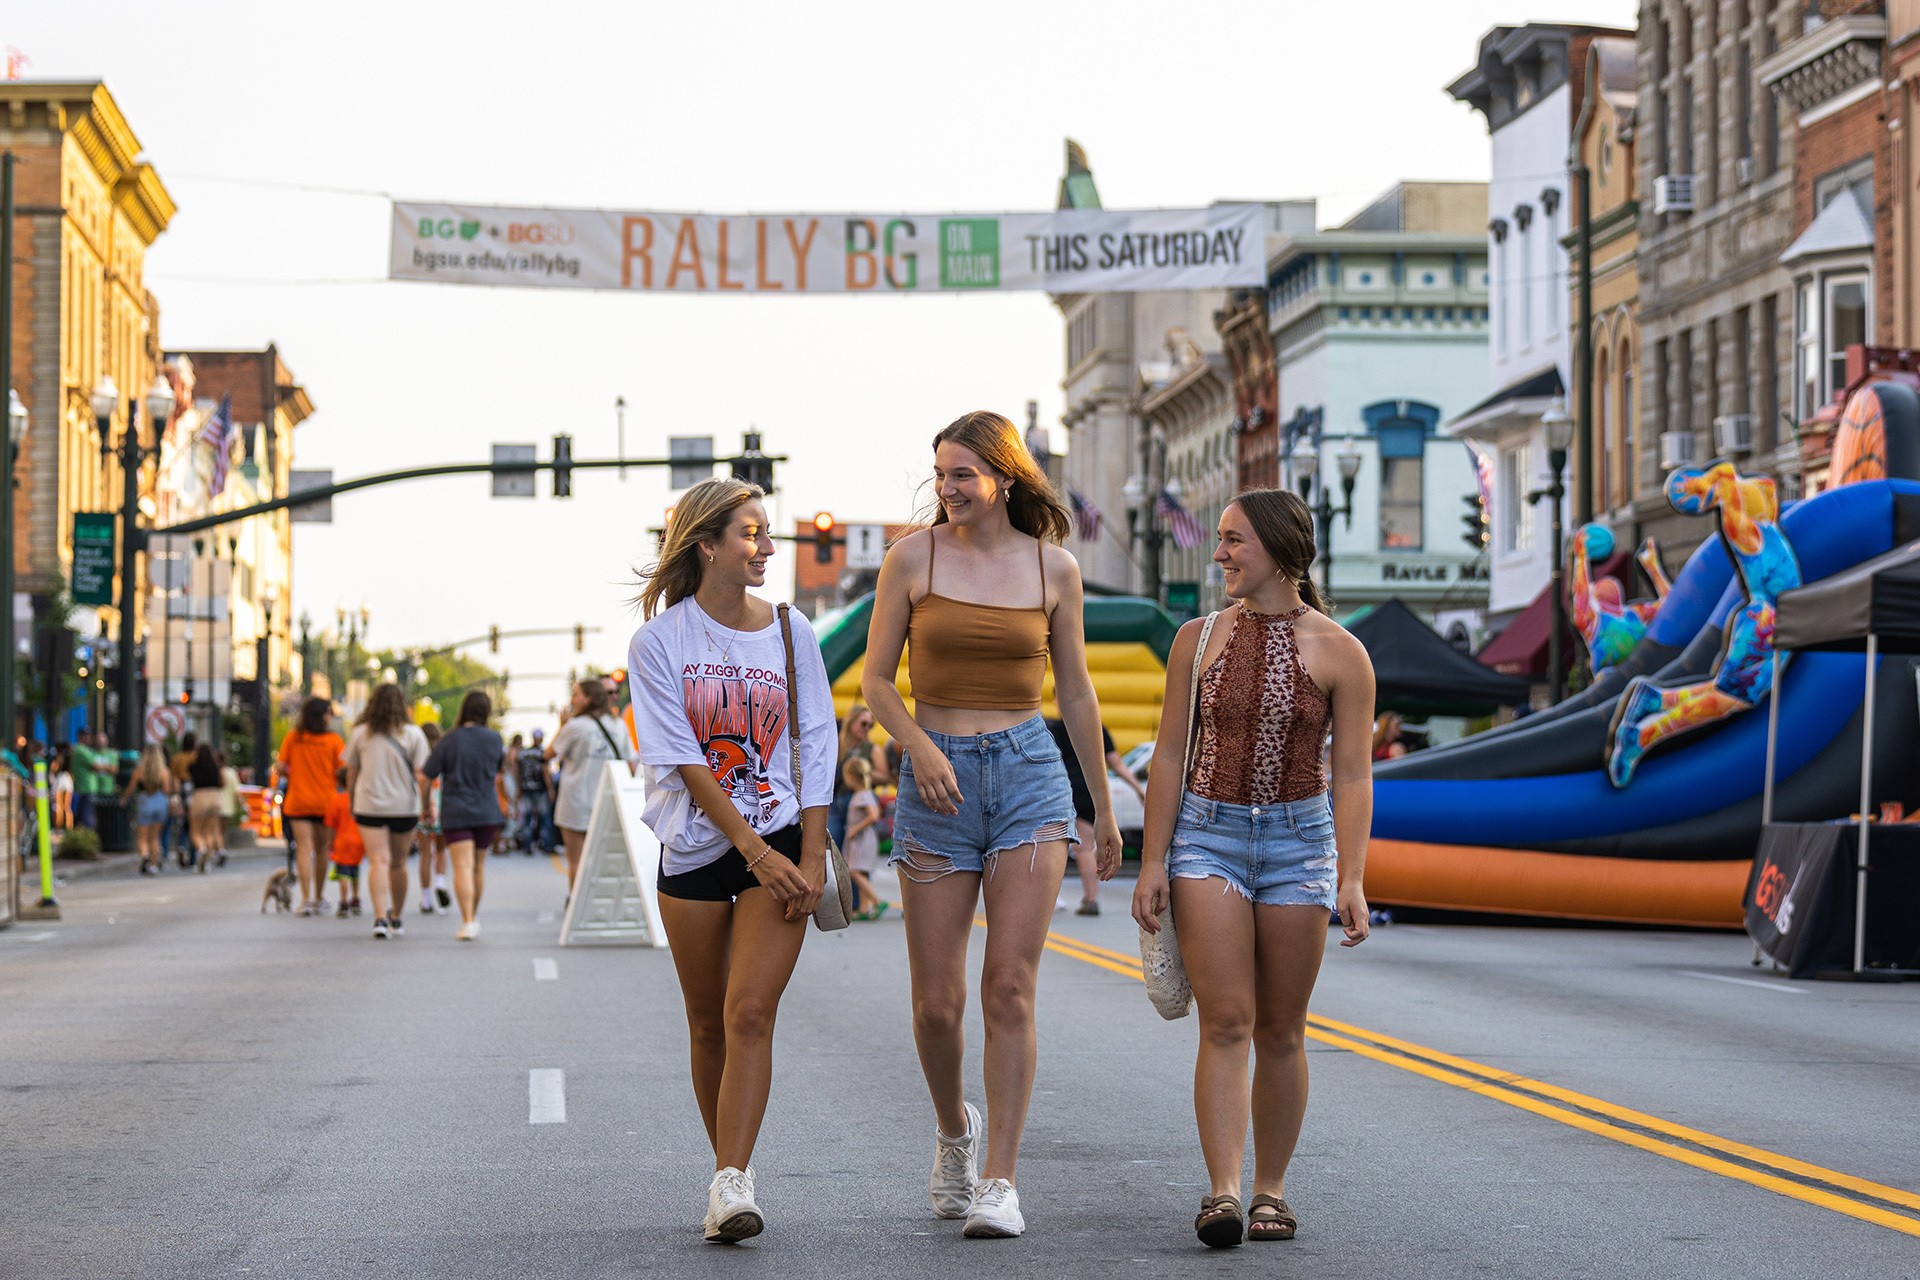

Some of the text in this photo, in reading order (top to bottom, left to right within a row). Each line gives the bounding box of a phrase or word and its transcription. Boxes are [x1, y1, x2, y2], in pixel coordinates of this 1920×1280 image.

[418, 218, 455, 238] BG
[508, 222, 575, 245] BGSU
[947, 223, 972, 250] ON
[413, 247, 580, 276] bgsu.edu/rallybg
[620, 216, 918, 289] RALLY BG
[1026, 228, 1243, 272] THIS SATURDAY
[947, 254, 993, 282] MAIN
[704, 664, 742, 678] ZIGGY
